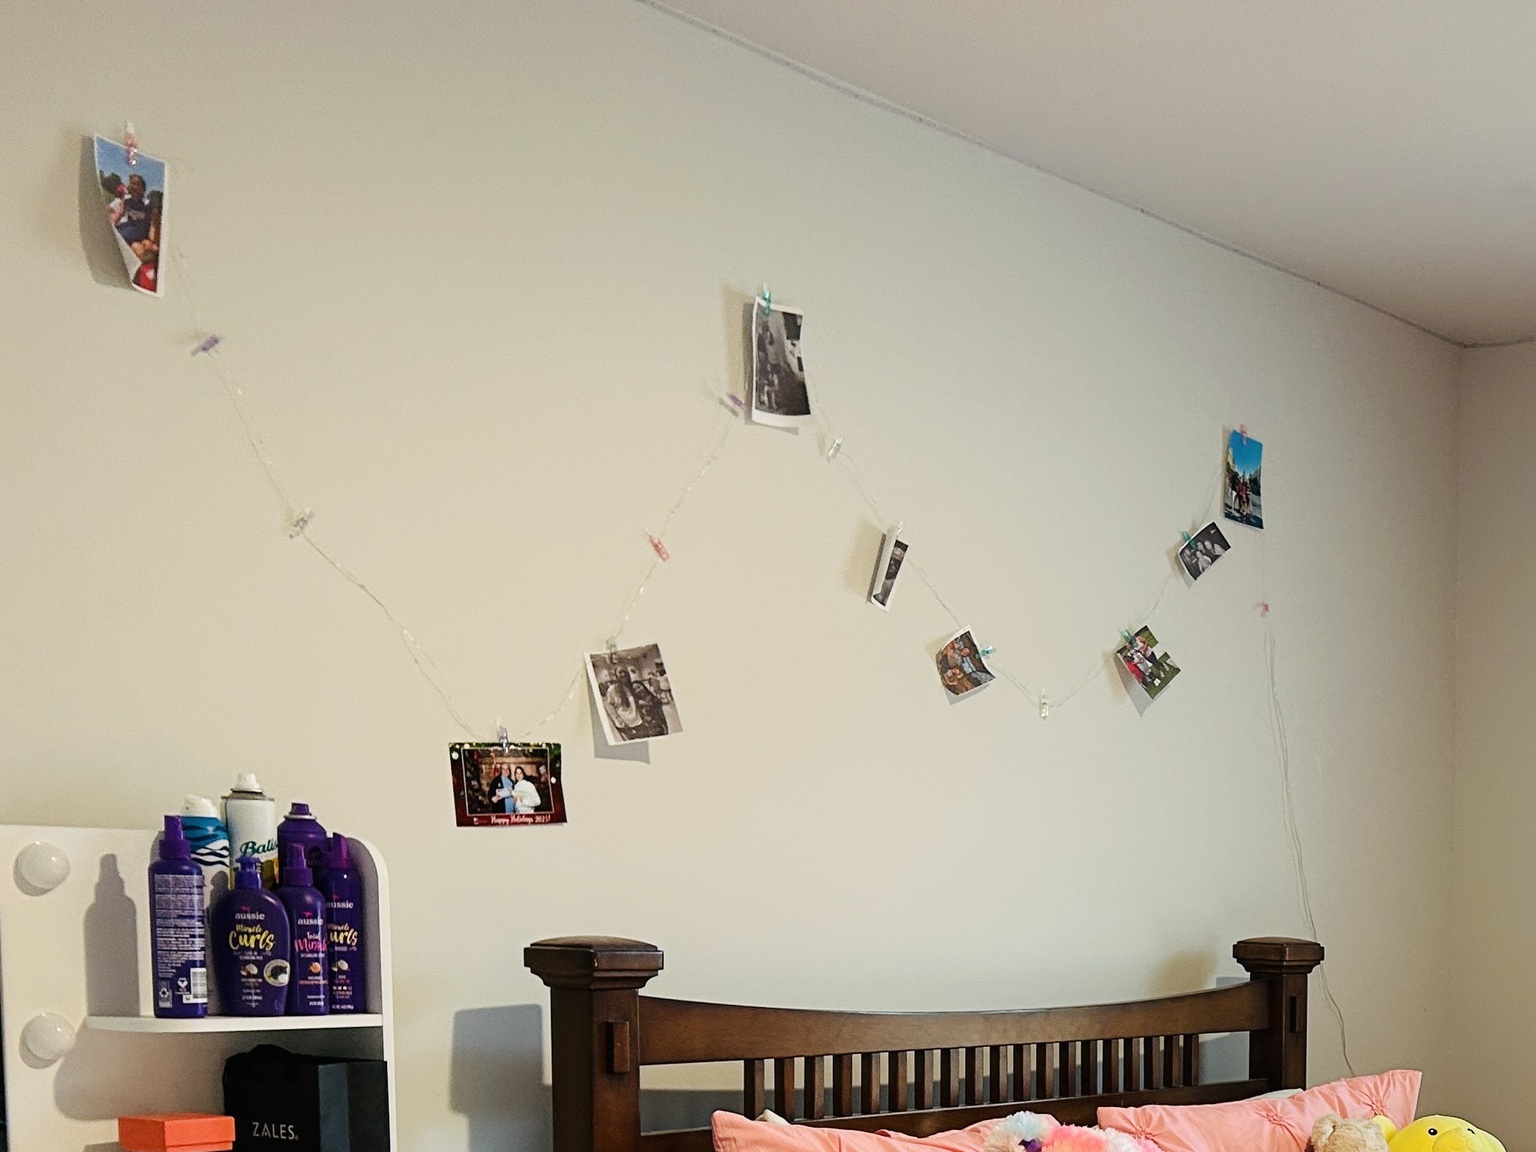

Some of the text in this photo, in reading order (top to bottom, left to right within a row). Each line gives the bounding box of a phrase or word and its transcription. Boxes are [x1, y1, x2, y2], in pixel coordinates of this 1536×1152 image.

[235, 911, 265, 921] aussie
[297, 917, 324, 926] aussie
[228, 930, 276, 951] Curls
[252, 1121, 295, 1140] ZALES
